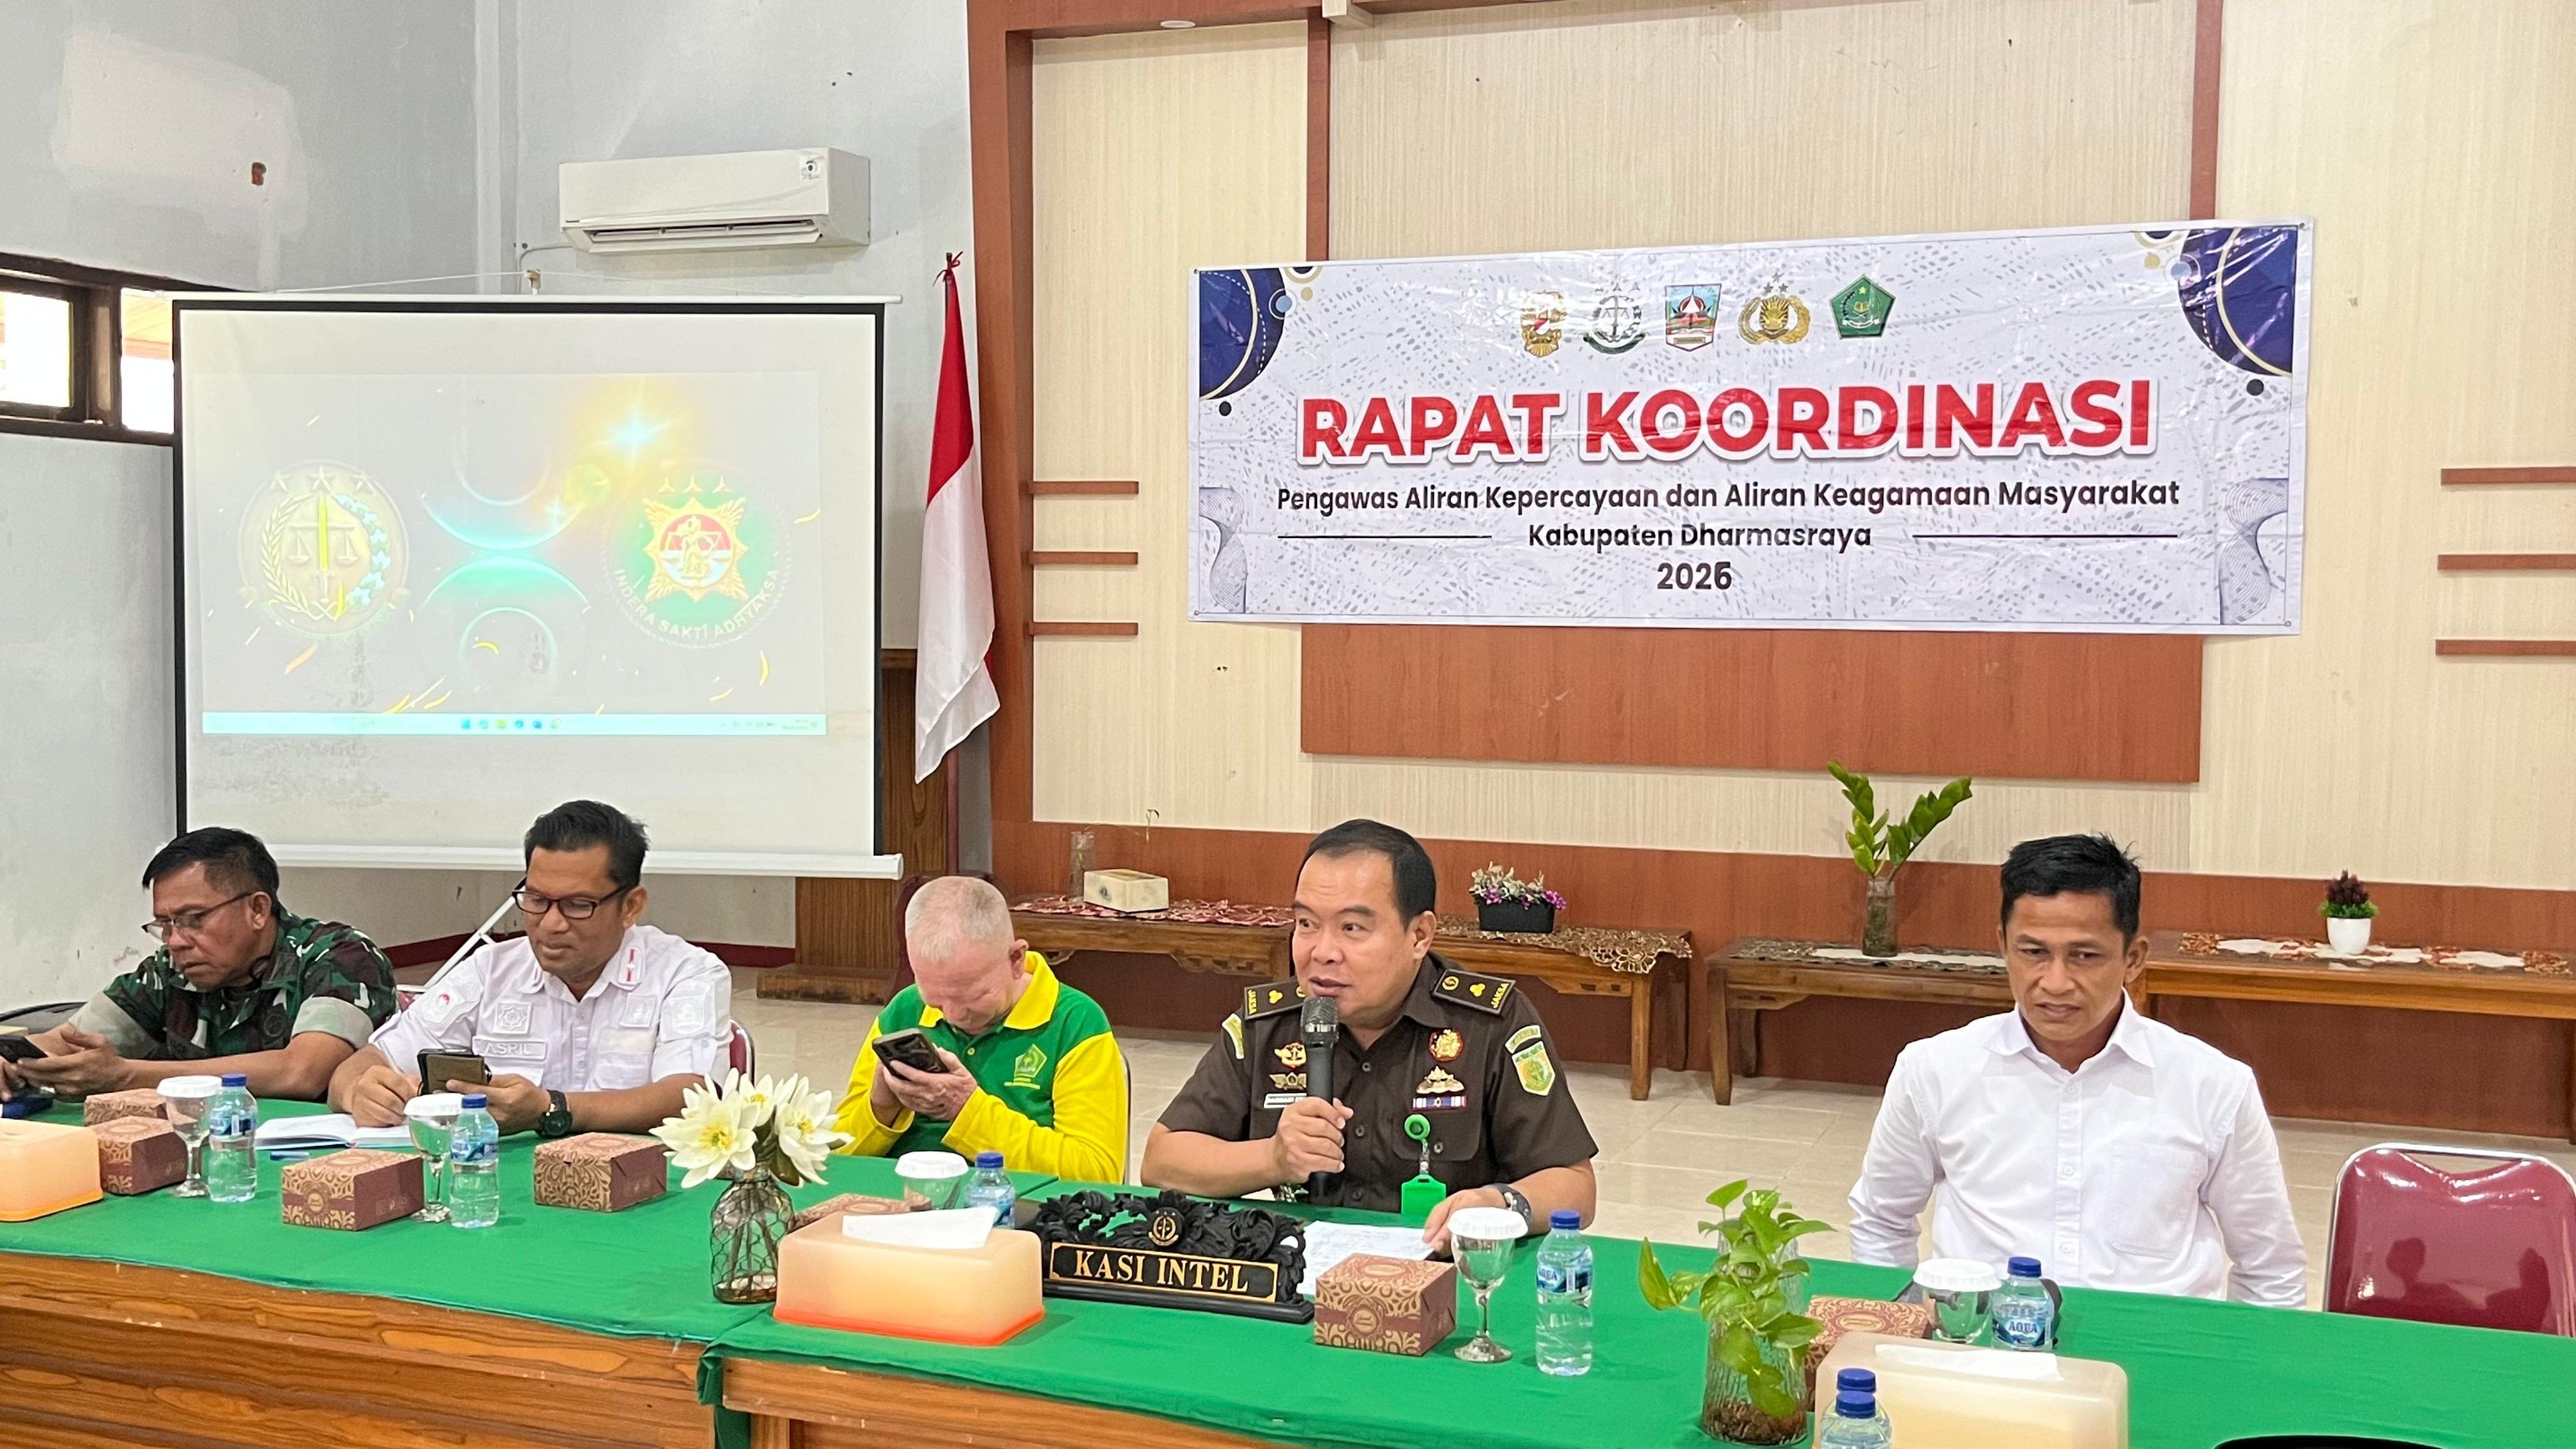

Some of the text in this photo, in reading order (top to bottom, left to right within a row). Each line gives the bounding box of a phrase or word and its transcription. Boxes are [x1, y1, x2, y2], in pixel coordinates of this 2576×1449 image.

[1301, 379, 2150, 457] RAPAT KOORDINASI
[1278, 480, 2179, 517] Pengawas Aliran Kepercayaan dan Aliran Keagamaan Masyarakat
[1529, 523, 1871, 554] Kabupaten Dharmasraya
[1657, 561, 1732, 590] 2026
[613, 569, 656, 626] INDERA
[659, 619, 709, 640] SAKTI
[1491, 983, 1510, 1009] JAKSA
[485, 1042, 532, 1055] ASRIL
[1074, 1250, 1249, 1293] KASI INTEL
[2008, 1320, 2037, 1335] AQUA
